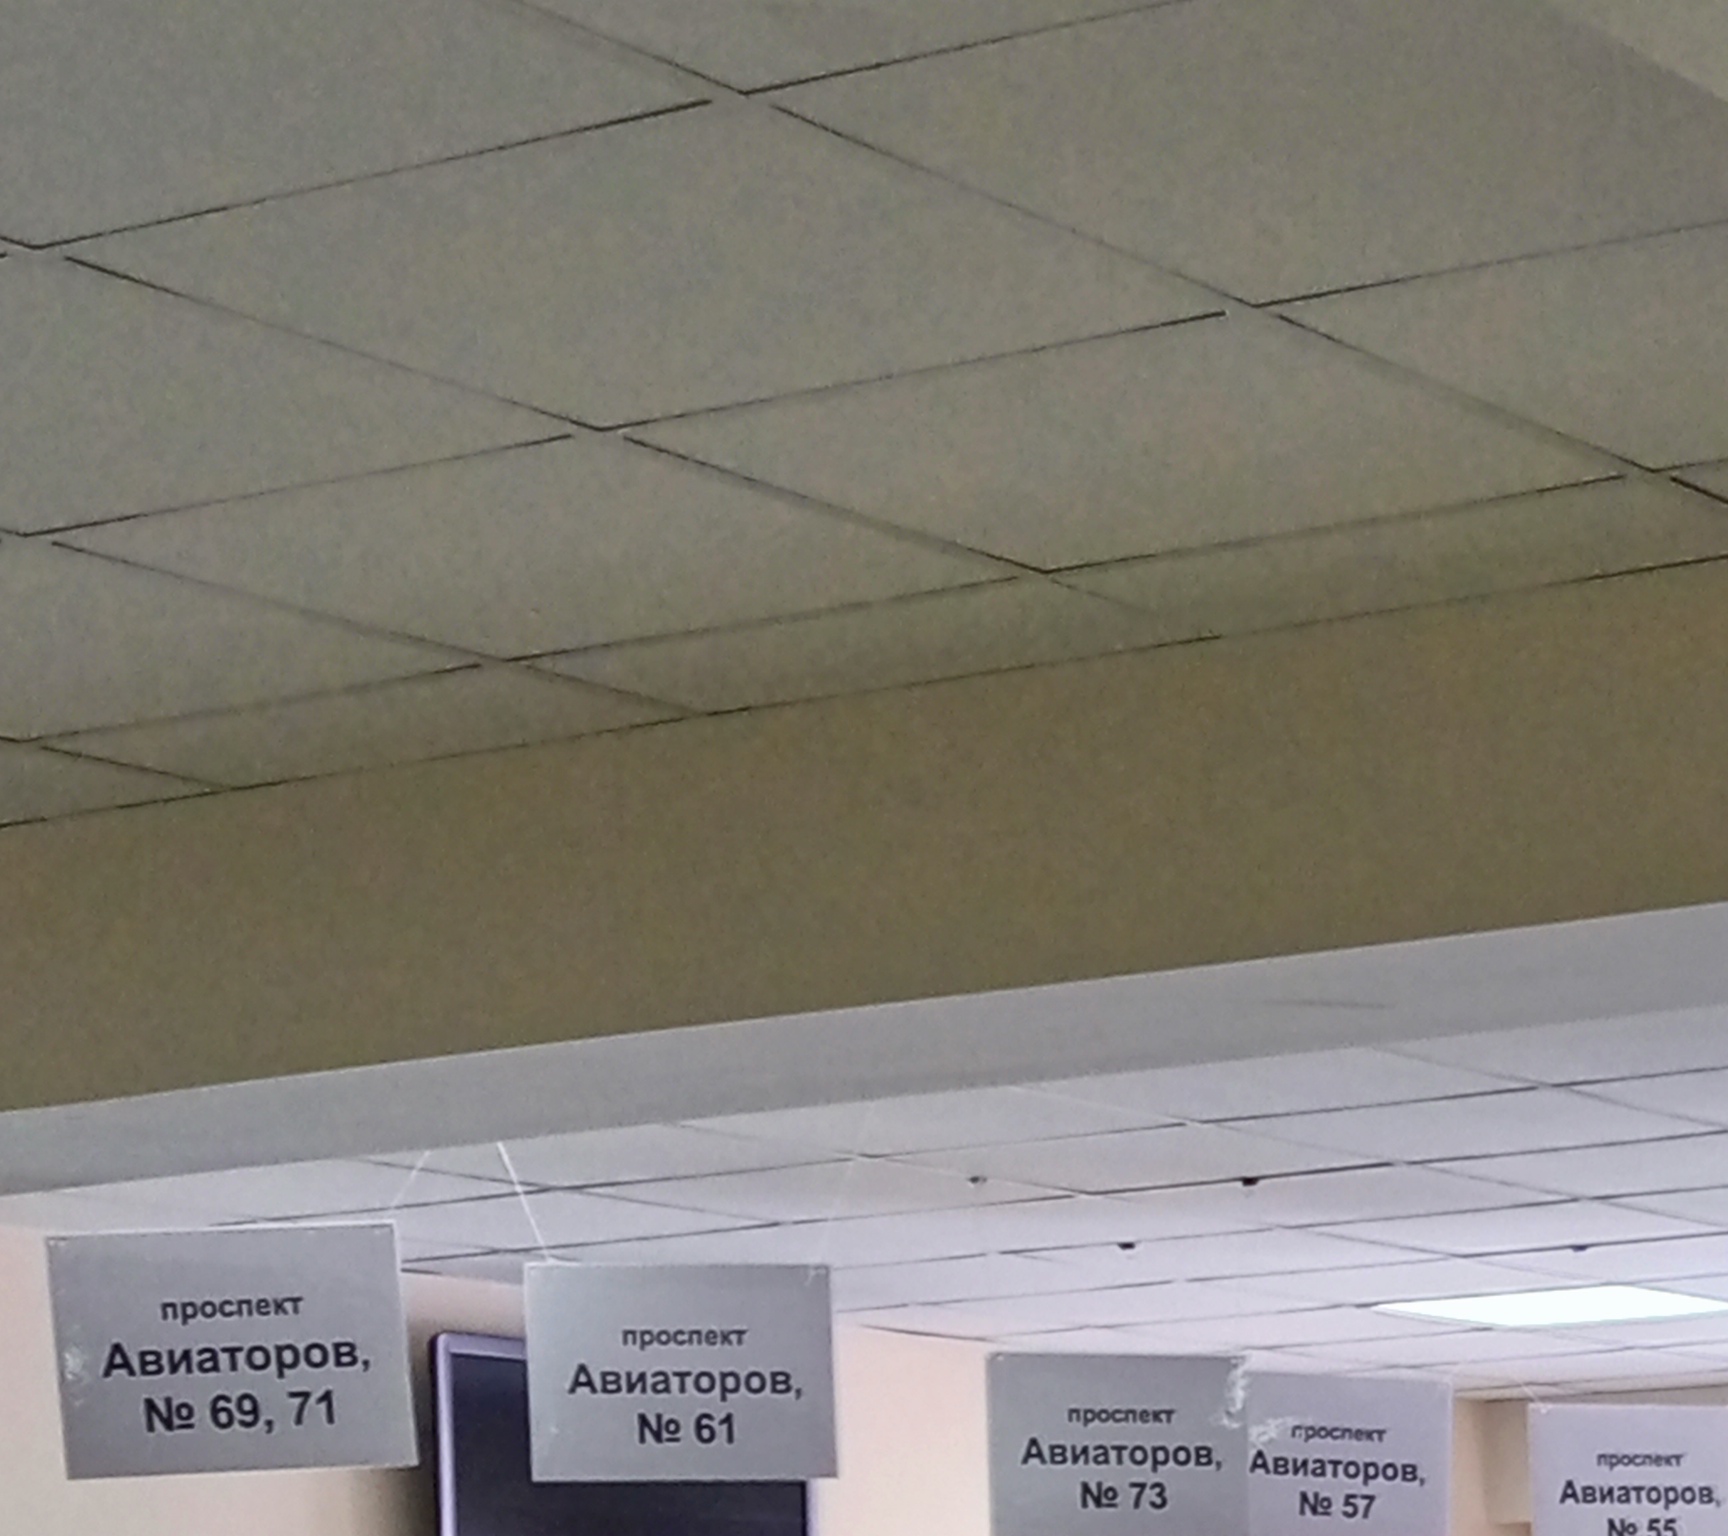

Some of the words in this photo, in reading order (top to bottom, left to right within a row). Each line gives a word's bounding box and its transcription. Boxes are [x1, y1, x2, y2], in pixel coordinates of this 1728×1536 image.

[161, 1297, 303, 1325] проспект
[622, 1328, 748, 1351] проспект
[102, 1342, 370, 1379] Авиаторов,
[567, 1363, 803, 1402] Авиаторов,
[144, 1397, 194, 1432] №
[210, 1393, 274, 1434] 69,
[288, 1389, 335, 1425] 71
[1067, 1408, 1175, 1427] проспект
[637, 1413, 681, 1444] №
[694, 1412, 735, 1444] 61
[1291, 1425, 1386, 1443] проспект
[1021, 1437, 1222, 1473] Авиаторов,
[1249, 1449, 1426, 1486] Авиаторов,
[1597, 1454, 1685, 1471] проспект
[1080, 1481, 1118, 1509] №
[1129, 1481, 1168, 1509] 73
[1299, 1491, 1332, 1516] №
[1342, 1494, 1376, 1519] 57
[1559, 1480, 1722, 1511] Авиаторов,
